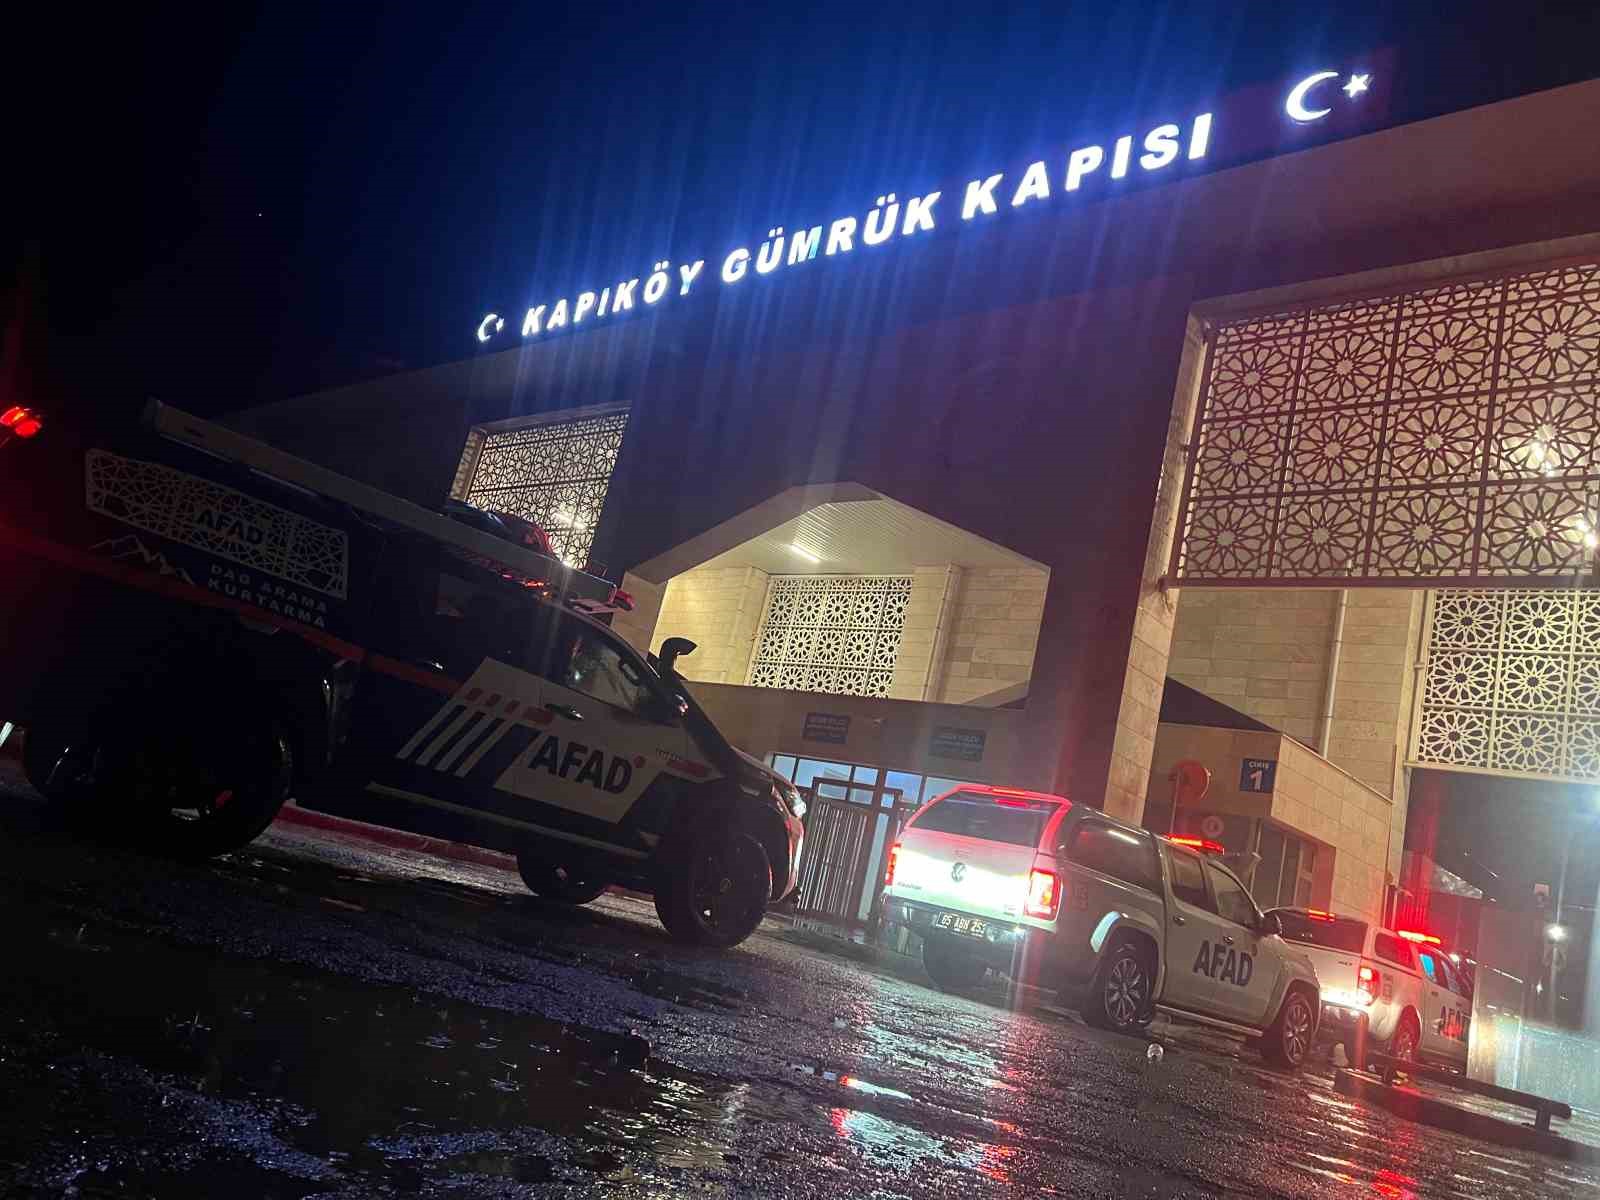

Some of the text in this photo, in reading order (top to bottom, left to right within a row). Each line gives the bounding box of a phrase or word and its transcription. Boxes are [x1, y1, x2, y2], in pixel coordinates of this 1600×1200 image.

[521, 113, 1213, 337] KAPIKÖY GÜMRÜK KAPISI
[192, 509, 264, 544] AFAD
[207, 577, 327, 630] KURTARMA
[259, 582, 329, 615] ARAMA
[528, 735, 632, 794] AFAD
[1250, 770, 1263, 790] 1
[1193, 938, 1253, 986] AFAD
